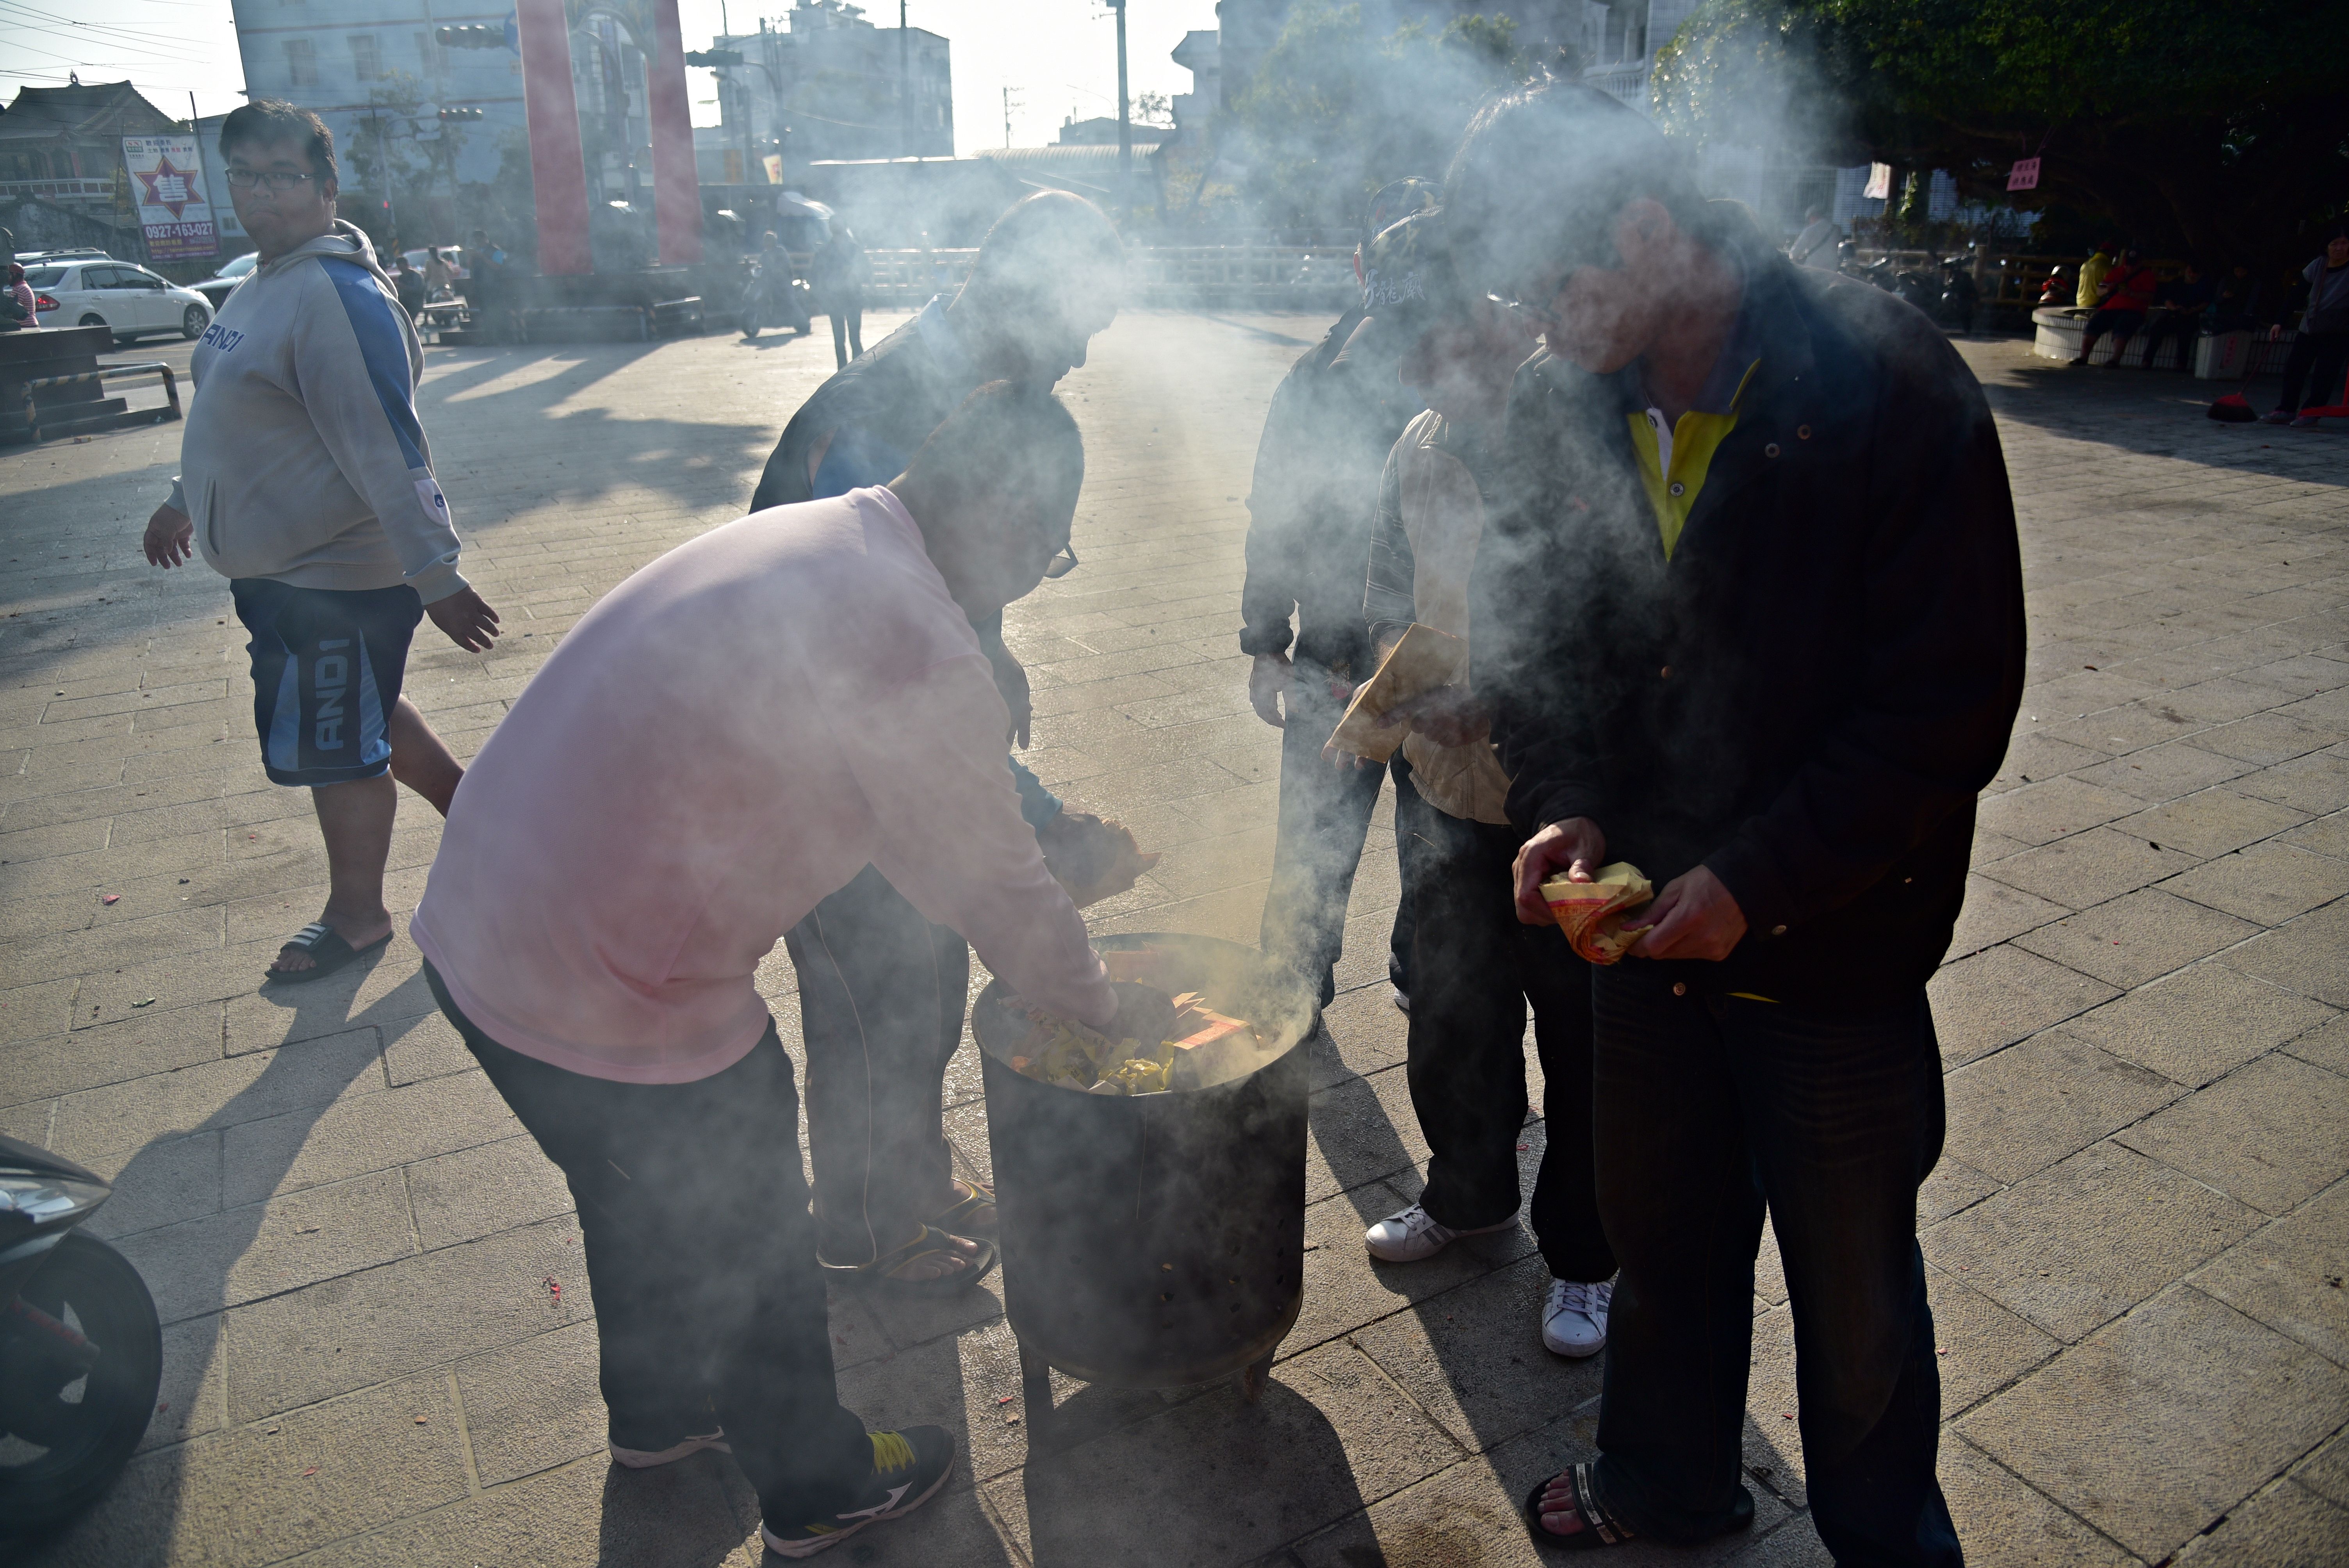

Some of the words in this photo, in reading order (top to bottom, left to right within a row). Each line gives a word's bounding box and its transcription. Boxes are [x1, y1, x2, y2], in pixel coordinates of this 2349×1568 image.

[153, 174, 189, 203] 售
[146, 222, 213, 239] 0927-163-027
[315, 639, 350, 750] AND1
